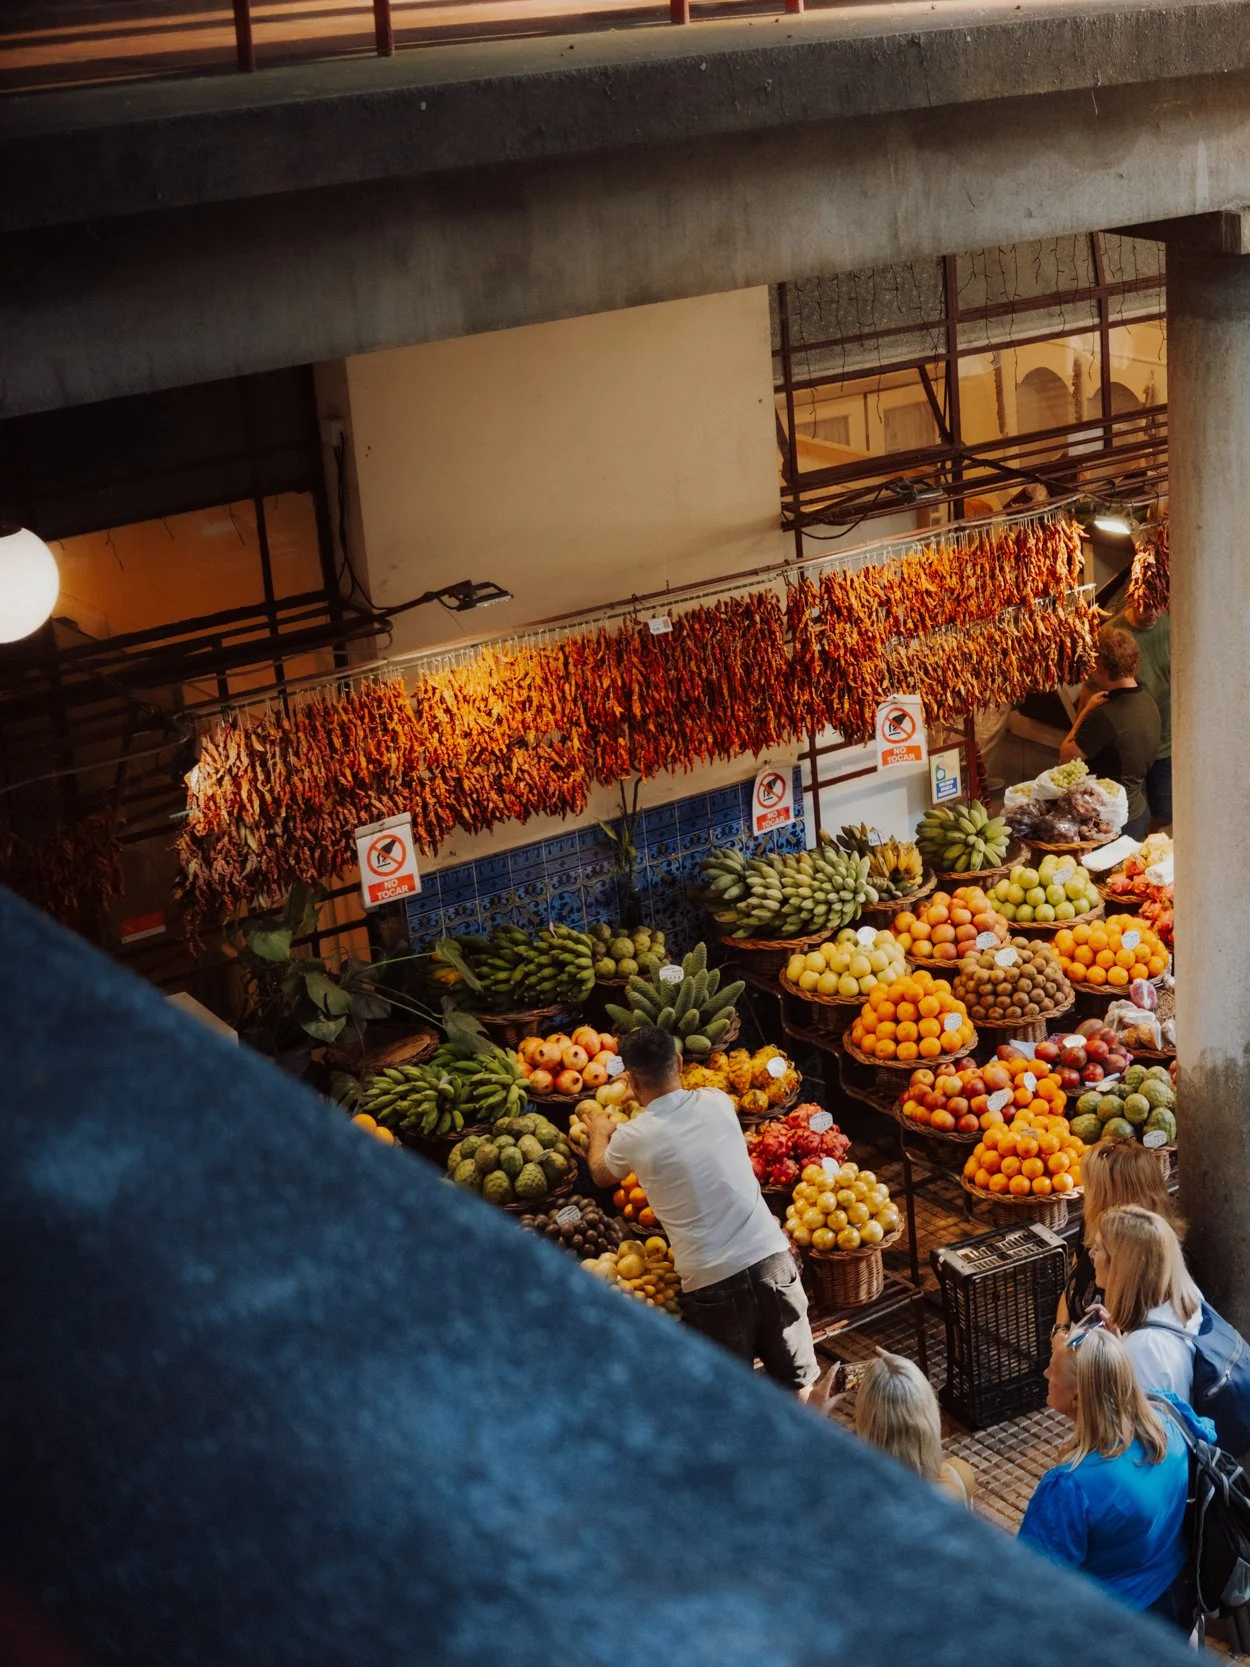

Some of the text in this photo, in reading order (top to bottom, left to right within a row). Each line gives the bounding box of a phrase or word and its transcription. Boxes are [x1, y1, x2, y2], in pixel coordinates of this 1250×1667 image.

[893, 745, 907, 755] NO
[887, 753, 915, 762] TOCAR
[766, 809, 778, 819] NO
[761, 815, 785, 829] TOCAR
[384, 879, 398, 889] NO
[377, 885, 409, 900] TOCAR
